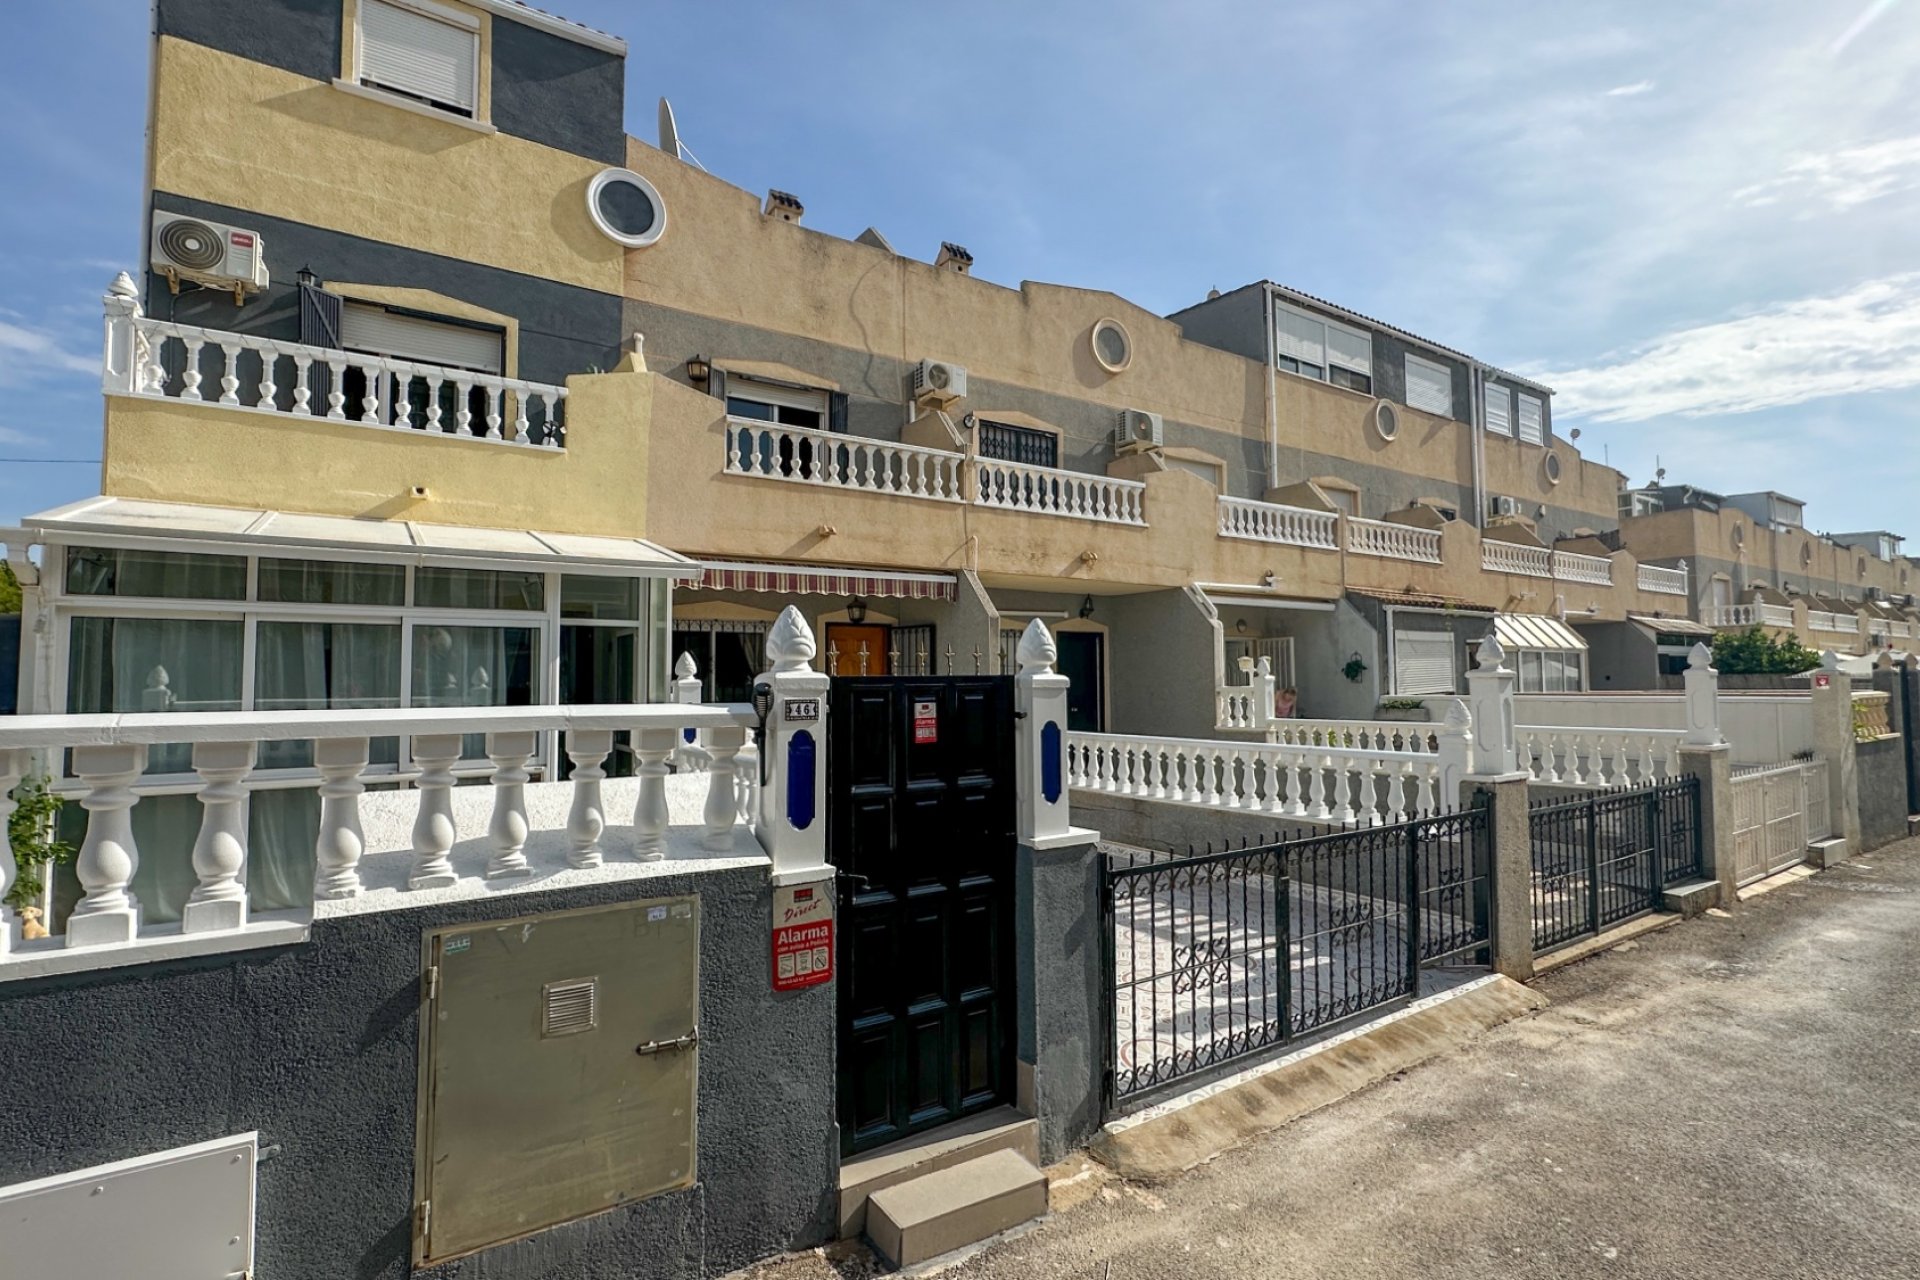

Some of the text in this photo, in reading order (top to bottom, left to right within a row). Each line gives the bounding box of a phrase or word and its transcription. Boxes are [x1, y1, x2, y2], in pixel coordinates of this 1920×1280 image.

[795, 703, 810, 716] 46
[783, 898, 822, 922] Direct
[777, 926, 829, 944] Alarma
